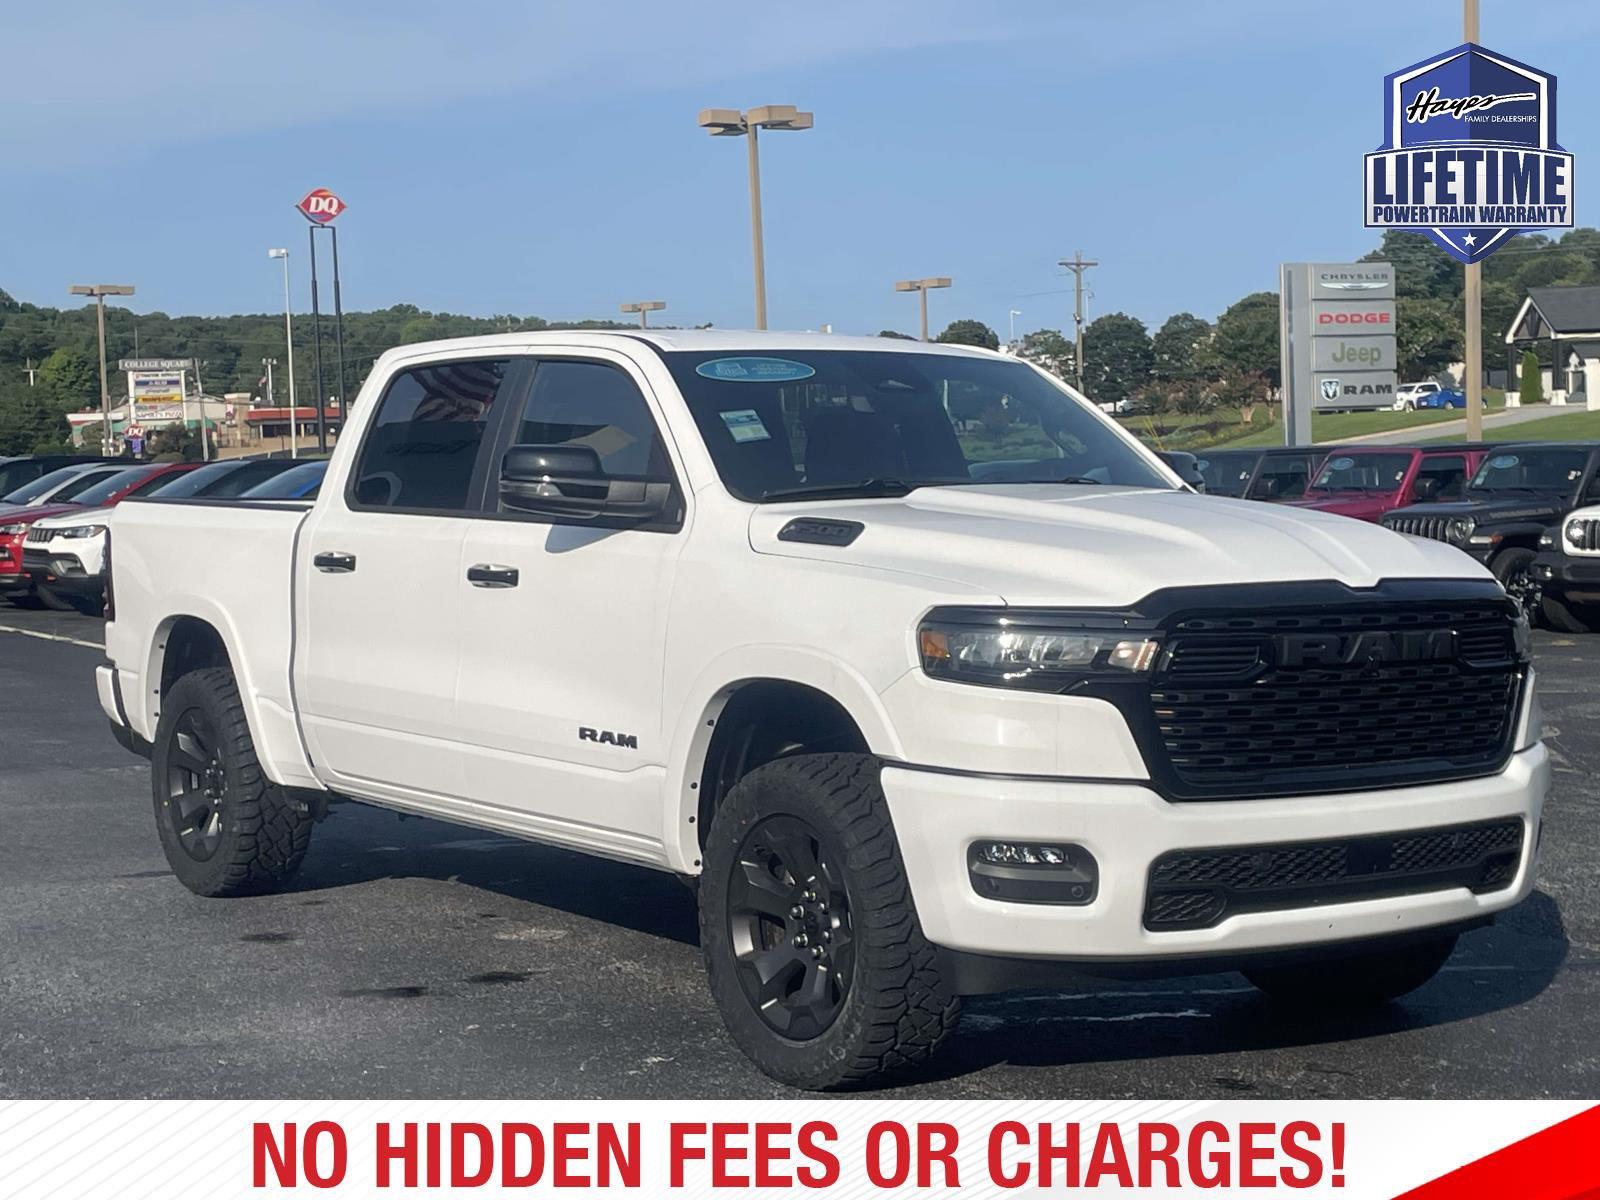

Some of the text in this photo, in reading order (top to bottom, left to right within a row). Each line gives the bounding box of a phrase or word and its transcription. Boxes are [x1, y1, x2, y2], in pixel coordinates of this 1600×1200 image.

[309, 197, 338, 215] DQ
[1319, 313, 1390, 324] DODGE
[1332, 342, 1381, 366] Jeep
[124, 361, 159, 369] COLLEGE
[1343, 384, 1392, 395] RAM
[128, 428, 144, 437] DQ
[1281, 630, 1454, 666] RAM
[579, 726, 638, 749] RAM
